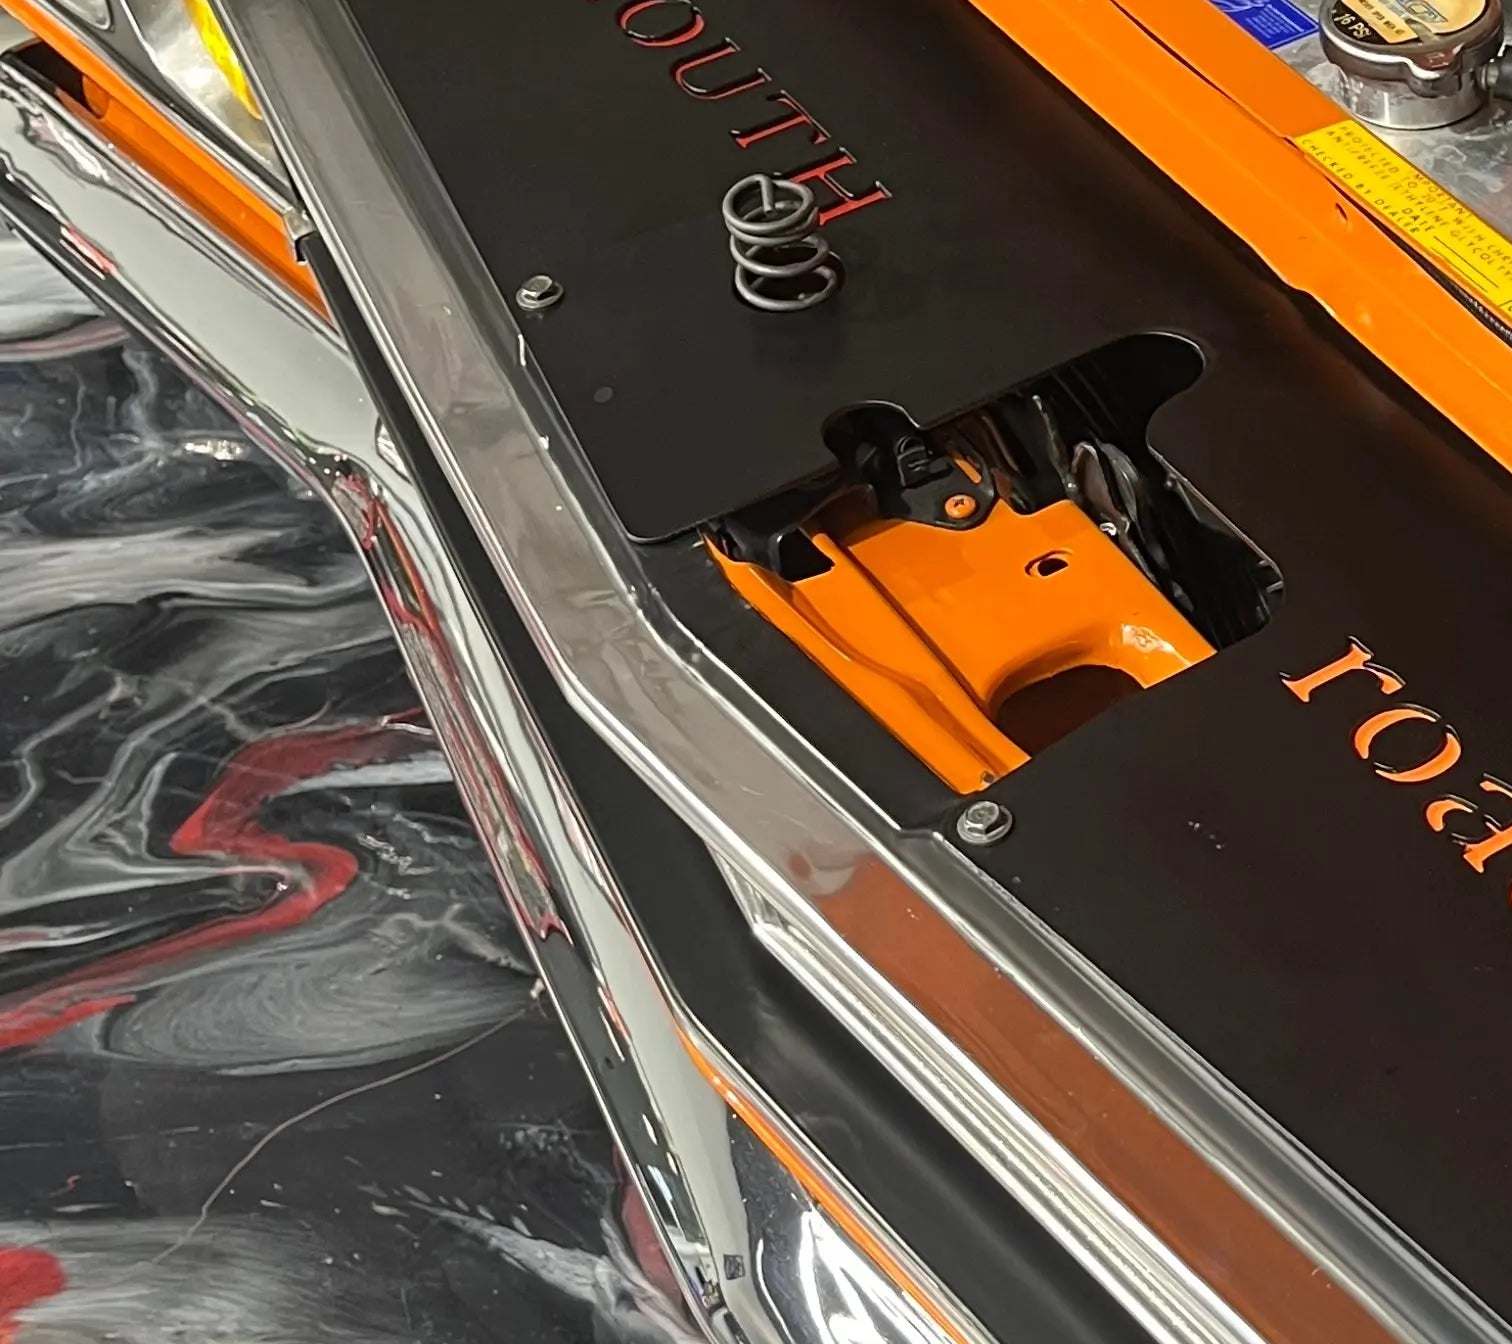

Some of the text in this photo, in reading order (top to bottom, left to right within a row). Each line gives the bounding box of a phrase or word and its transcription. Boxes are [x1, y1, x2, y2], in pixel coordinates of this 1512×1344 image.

[1300, 138, 1419, 234] CHECKED BY DEALER
[1408, 169, 1472, 219] MPORTANT
[1401, 206, 1435, 232] DATE
